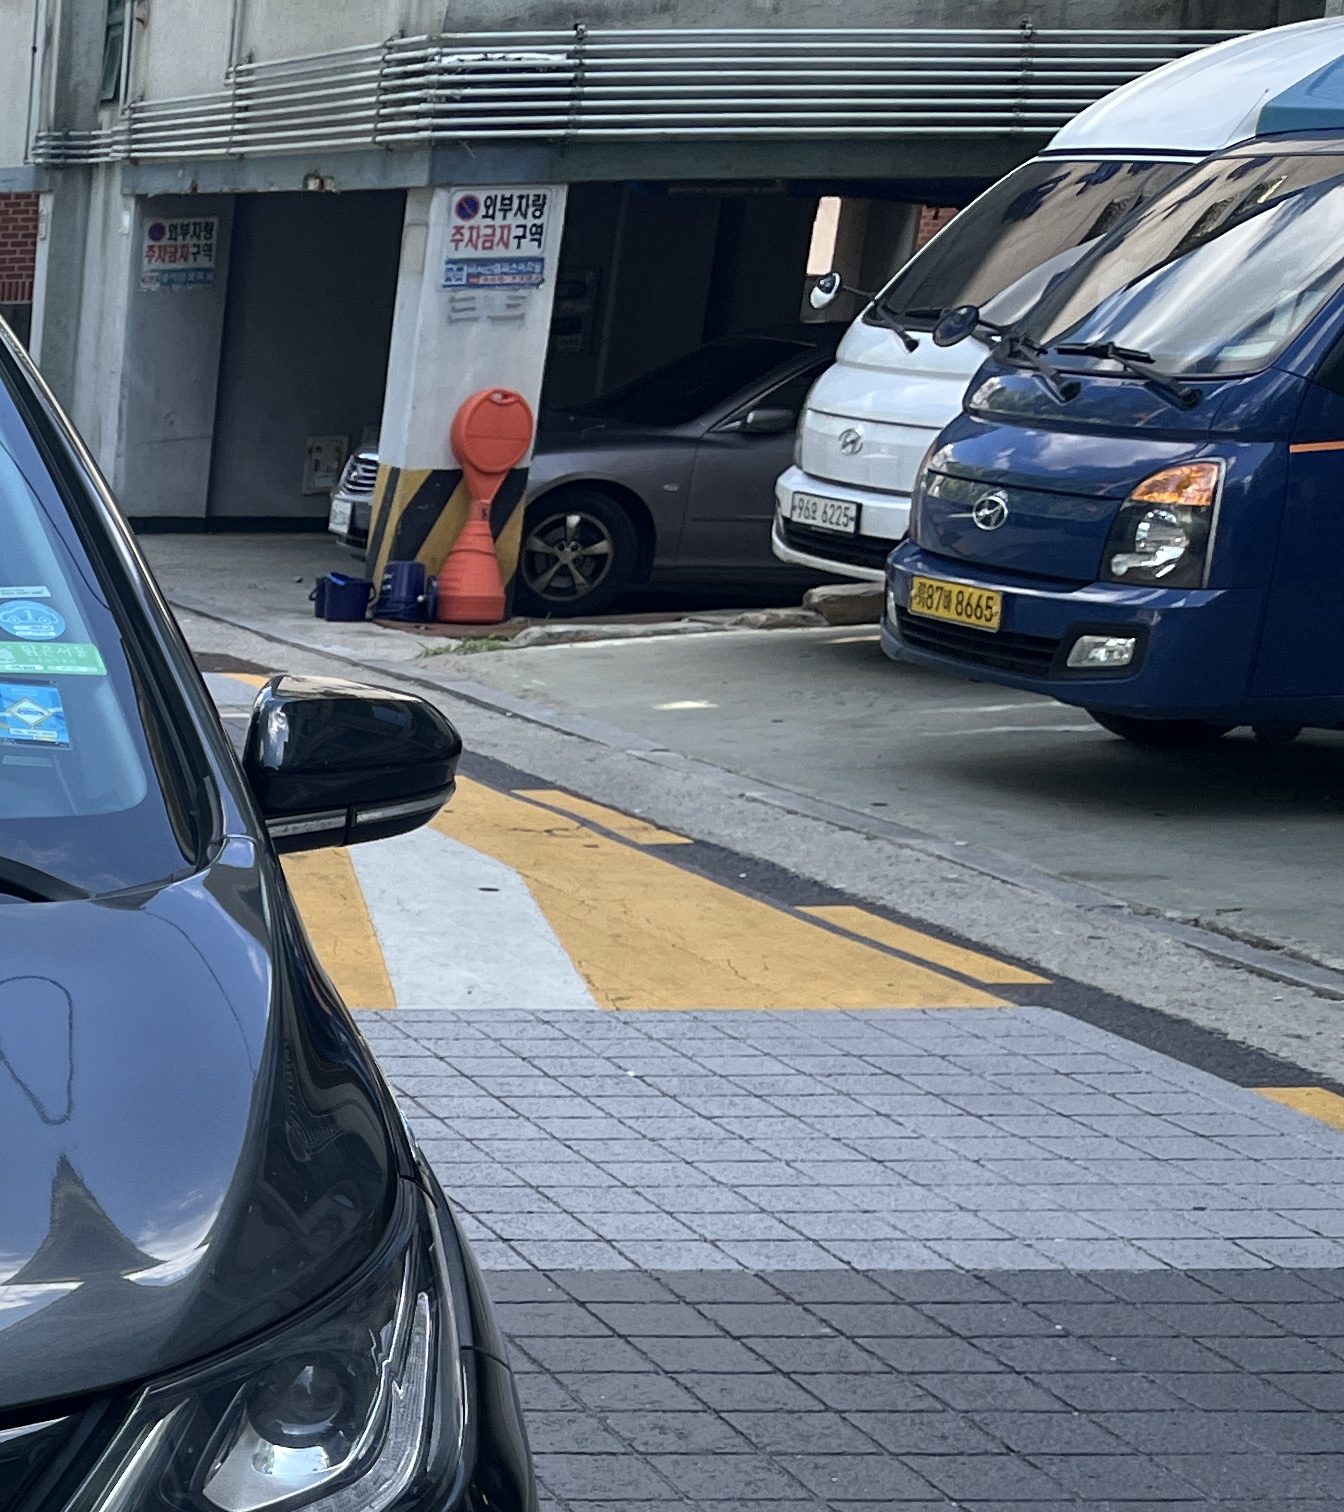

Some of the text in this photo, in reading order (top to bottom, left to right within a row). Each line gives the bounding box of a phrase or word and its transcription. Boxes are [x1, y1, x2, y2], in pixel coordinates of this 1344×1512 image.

[481, 193, 547, 221] 외부차량
[821, 502, 850, 528] 6225
[955, 590, 994, 622] 8665
